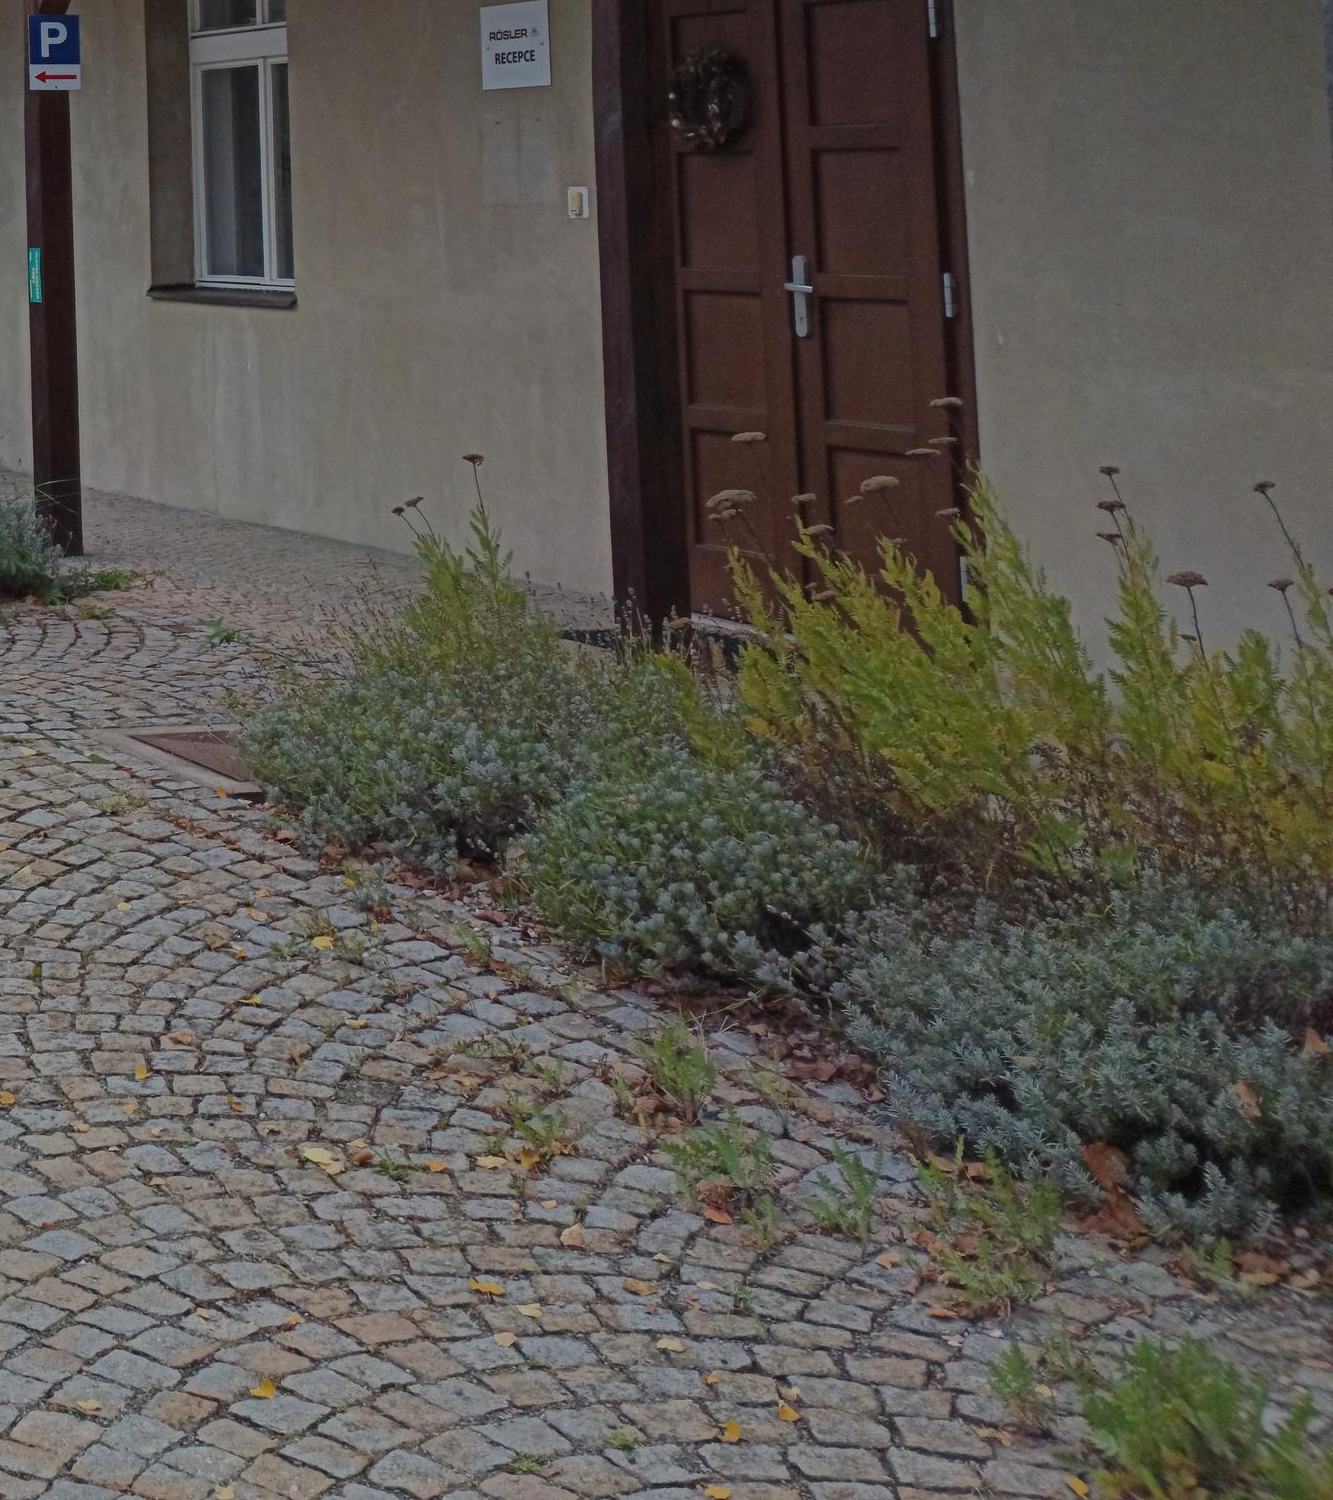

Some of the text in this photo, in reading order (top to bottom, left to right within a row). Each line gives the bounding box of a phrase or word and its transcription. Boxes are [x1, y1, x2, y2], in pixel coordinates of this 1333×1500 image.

[40, 21, 68, 58] P
[489, 28, 528, 41] RÖSLER
[495, 50, 535, 65] RECEPCE
